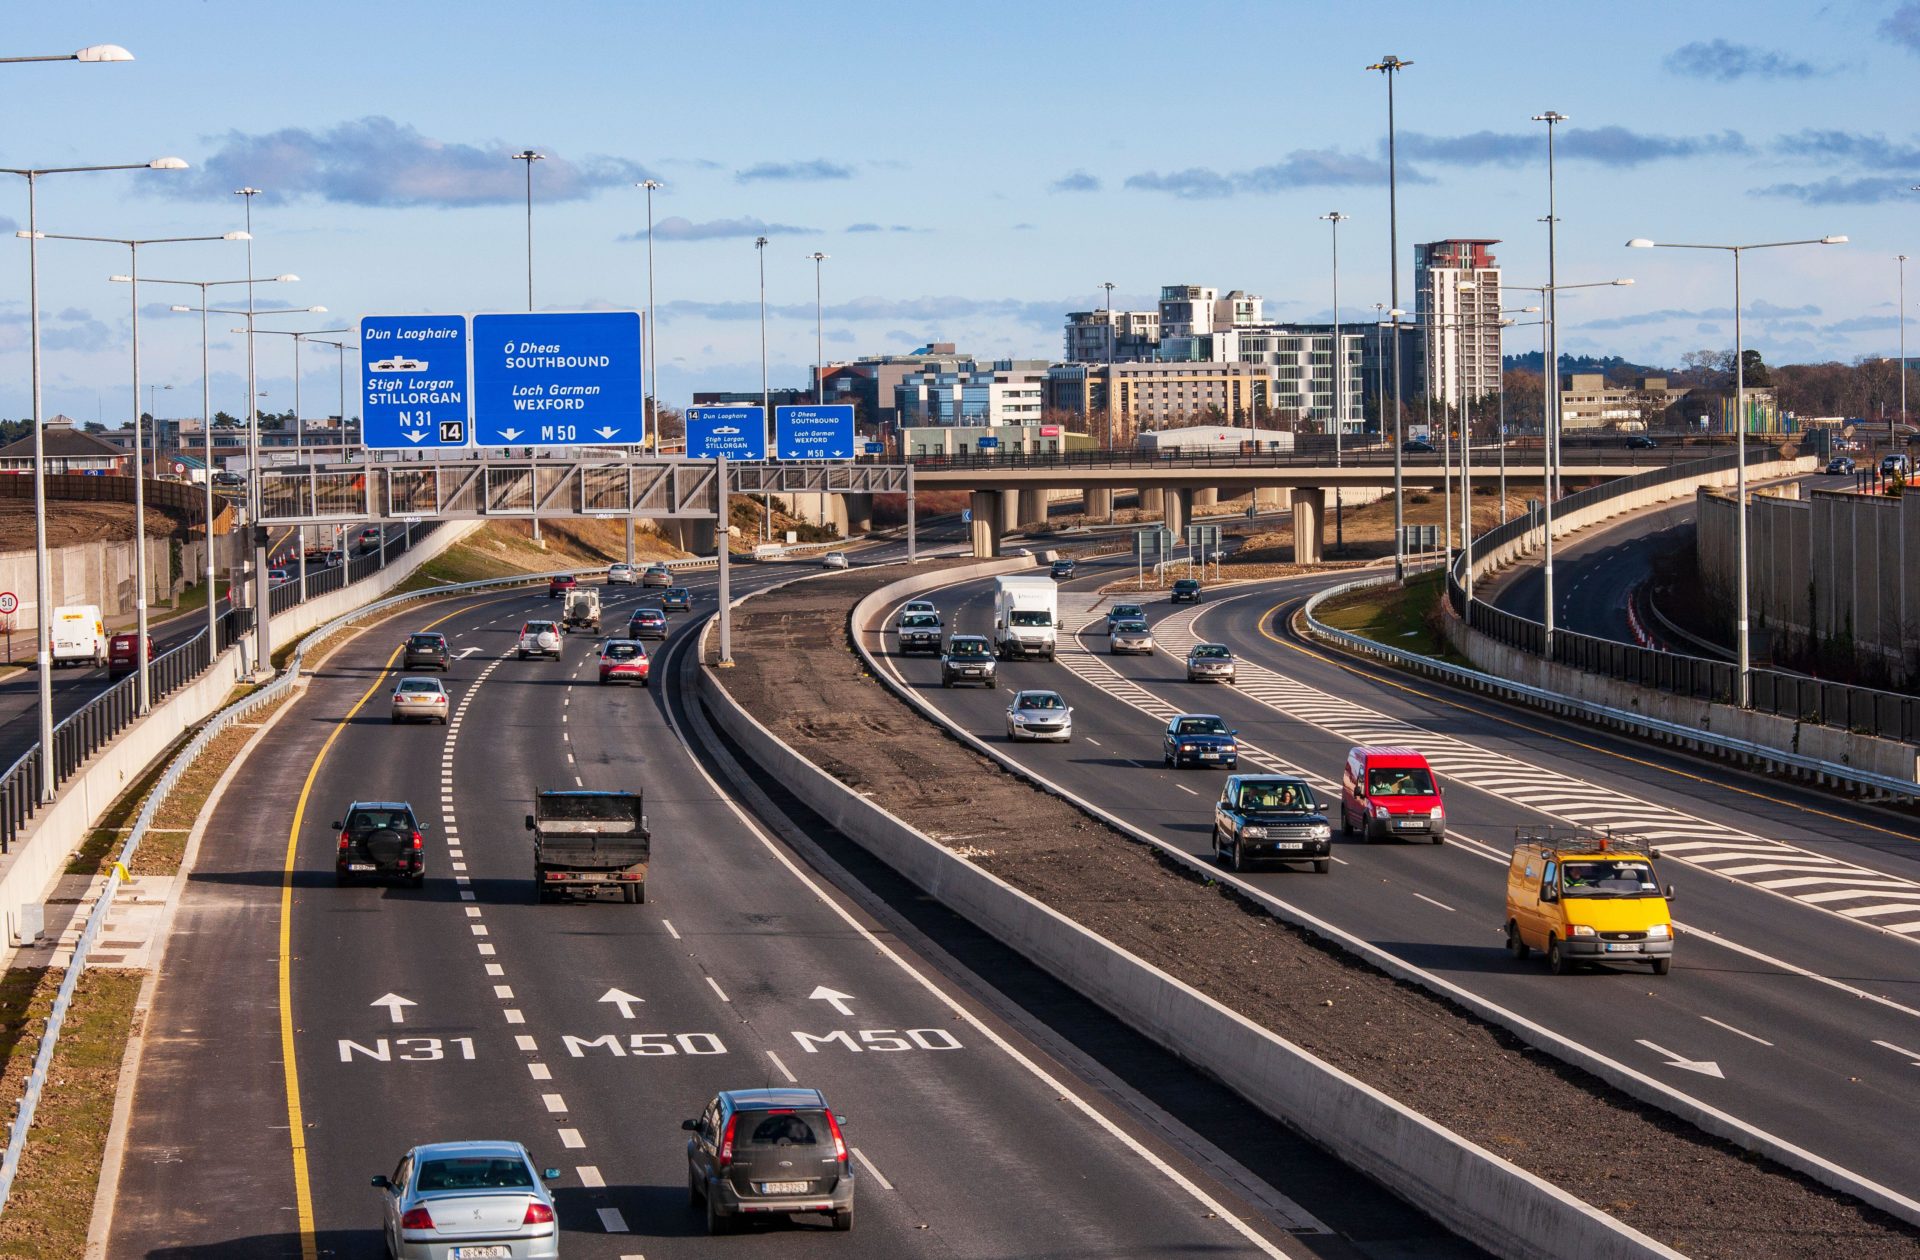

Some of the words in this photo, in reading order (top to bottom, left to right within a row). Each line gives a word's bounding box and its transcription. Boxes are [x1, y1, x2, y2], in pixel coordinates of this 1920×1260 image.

[366, 328, 391, 340] Dún
[396, 327, 458, 341] Laoghaire
[504, 340, 515, 354] Ó
[519, 342, 561, 354] Dheas
[505, 356, 610, 369] SOUTHBOUND
[367, 378, 403, 392] Stigh
[408, 378, 454, 391] Lorgan
[512, 384, 543, 396] Loch
[549, 384, 601, 396] Garman
[368, 392, 461, 405] STILLORGAN
[513, 398, 585, 411] WEXFORD
[688, 411, 698, 419] 14
[441, 424, 461, 440] 14
[1, 597, 13, 607] 50
[561, 1033, 728, 1058] M50
[790, 1028, 964, 1053] M50
[338, 1037, 476, 1062] N31
